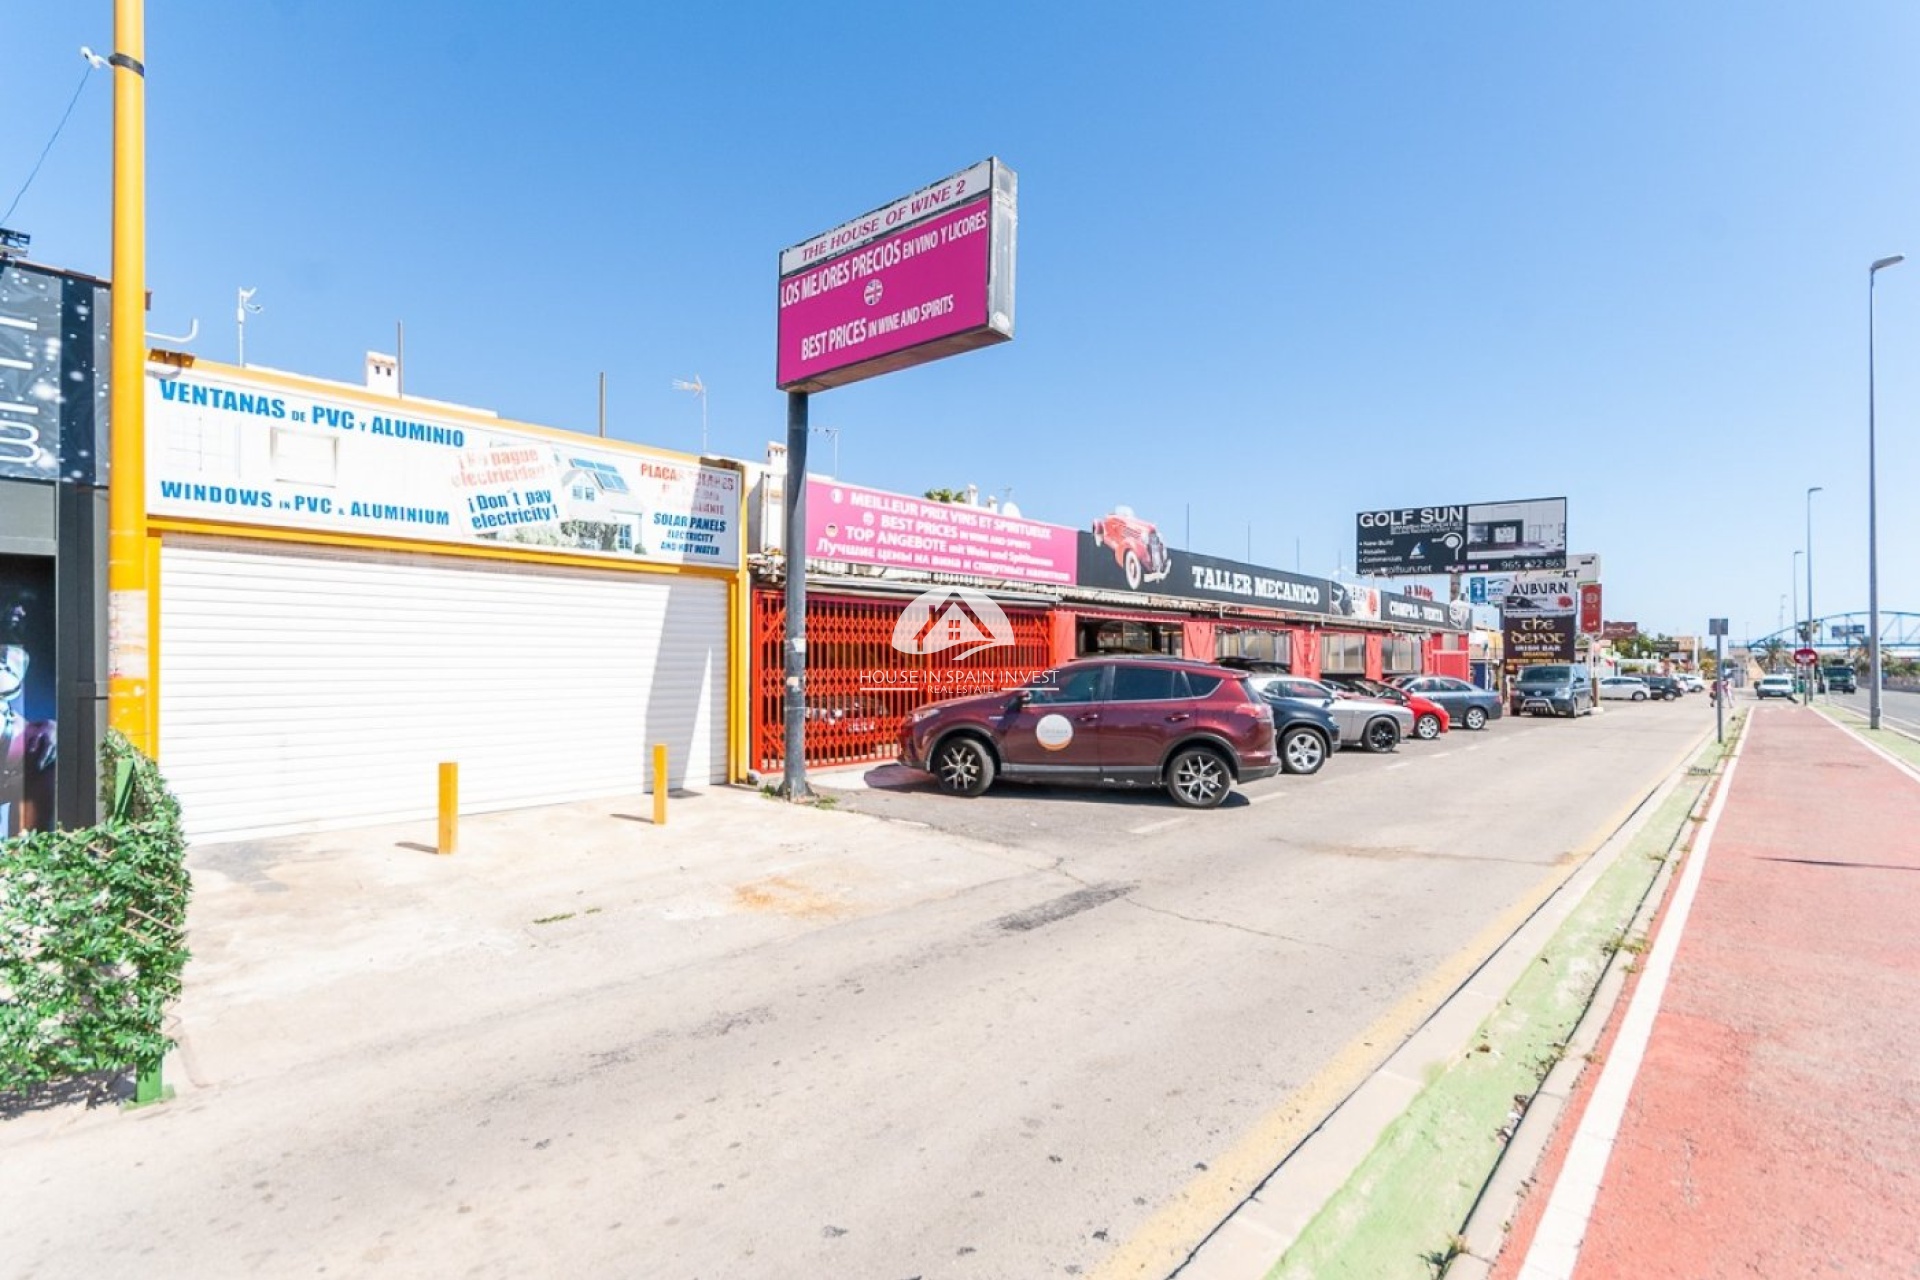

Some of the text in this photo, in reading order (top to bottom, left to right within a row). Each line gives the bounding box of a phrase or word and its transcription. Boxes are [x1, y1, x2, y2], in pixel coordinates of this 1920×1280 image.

[803, 179, 966, 262] THE HOUSE OF WINE 2
[781, 209, 988, 309] LOS MEJORES PRECIOS EN VINO Y LICORES
[801, 294, 954, 361] BEST PRICES IN WINE AND SPIRITS
[159, 378, 465, 448] VENTANAS DE PVC Y ALUMINIO
[160, 480, 273, 508] WINDOWS
[279, 499, 290, 510] IN
[294, 495, 332, 515] PVC
[350, 501, 450, 526] ALUMINIUM
[525, 489, 551, 506] pay
[849, 491, 918, 516] MEILLEUR
[921, 504, 949, 521] PRIX
[949, 511, 978, 527] VINS
[653, 512, 727, 533] SOLAR PANELS
[881, 514, 913, 532] BEST
[915, 521, 958, 538] PRICES
[1359, 506, 1463, 527] GOLF SUN
[667, 529, 714, 543] ELECTRICITY
[679, 543, 693, 553] HOT
[694, 545, 720, 555] WATER
[845, 525, 875, 542] TOP
[877, 530, 947, 553] ANGEBOTE
[1191, 565, 1252, 594] TALLER
[1254, 577, 1320, 605] MECANICO
[1511, 582, 1569, 595] AUBURN
[1542, 644, 1562, 652] BAR
